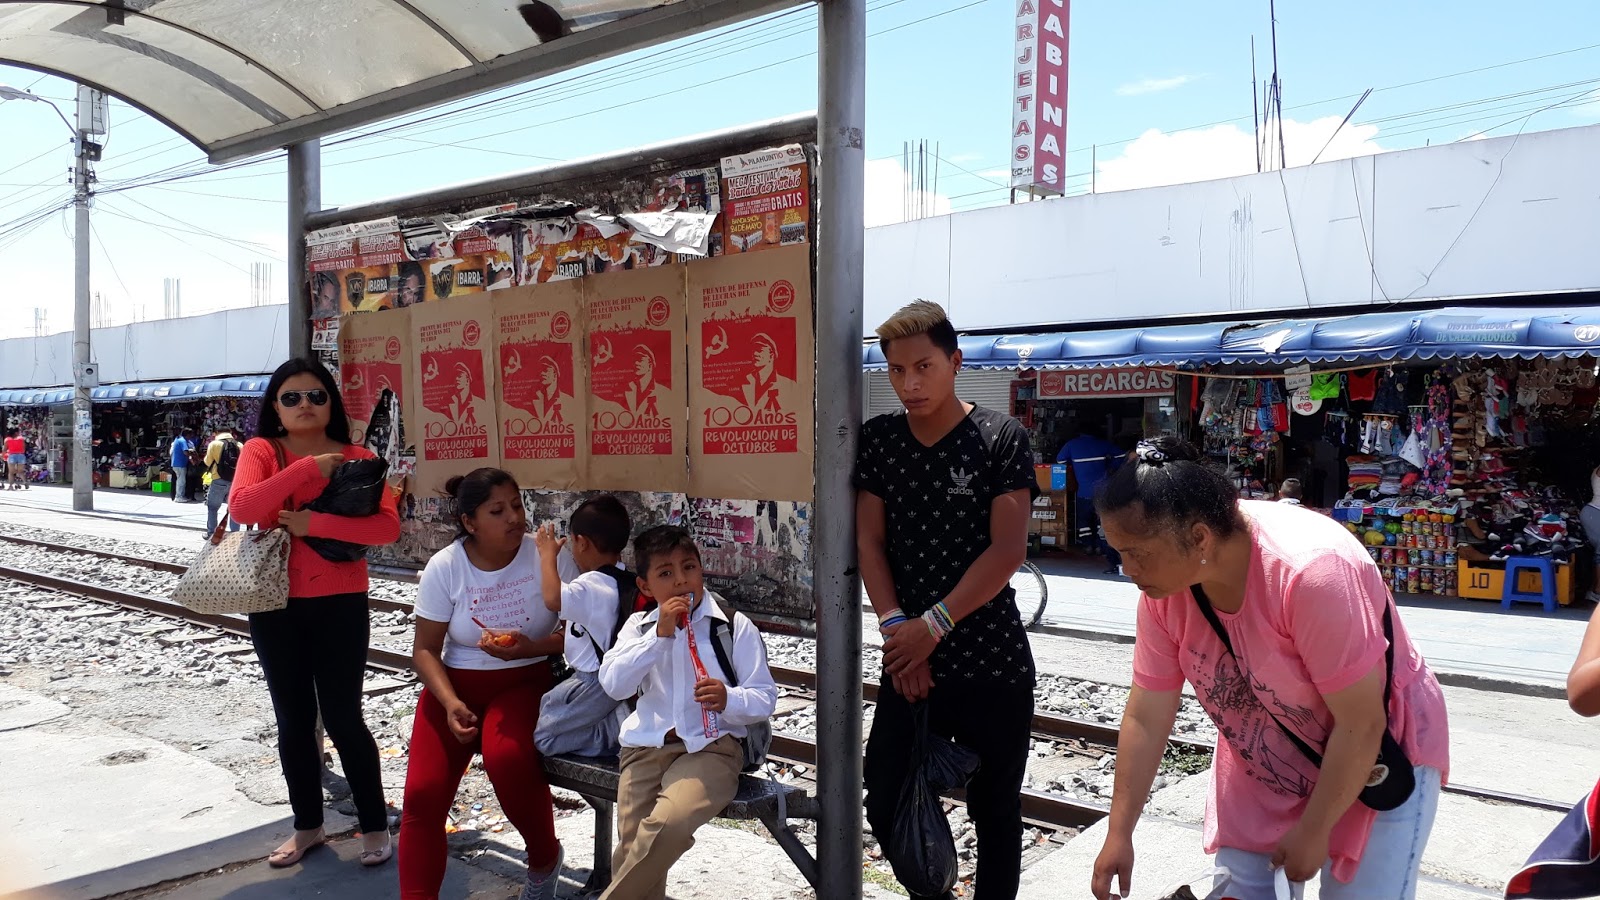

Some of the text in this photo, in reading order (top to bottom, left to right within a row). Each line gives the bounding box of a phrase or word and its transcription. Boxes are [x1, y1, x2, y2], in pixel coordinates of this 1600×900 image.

[729, 184, 759, 200] Bandas
[772, 176, 801, 192] Pueblo
[771, 192, 802, 210] GRATIS
[745, 222, 763, 230] MAYO
[336, 258, 355, 270] GRATIS
[556, 262, 584, 277] IBARRA
[458, 271, 480, 285] IBARRA
[368, 279, 388, 292] IBARRA
[703, 286, 728, 295] FRENTE
[738, 280, 767, 290] DEFENSA
[712, 291, 737, 301] LUCHAS
[590, 299, 612, 308] FRENTE
[621, 296, 646, 304] DEFENSA
[703, 300, 727, 309] PUEBLO
[598, 306, 620, 314] LUCHAS
[1436, 332, 1446, 342] DE
[1578, 328, 1596, 339] 27
[1065, 370, 1175, 392] RECARGAS
[659, 432, 671, 442] DE
[782, 429, 796, 440] DE
[477, 438, 487, 447] DE
[563, 438, 574, 447] DE
[723, 441, 777, 453] OCTUBRE
[438, 449, 474, 459] OCTUBRE
[520, 448, 560, 458] OCTUBRE
[609, 444, 655, 454] OCTUBRE
[948, 486, 974, 495] adidas
[1468, 573, 1490, 588] 10
[480, 589, 522, 603] Mickey's
[473, 598, 526, 613] sweetheart
